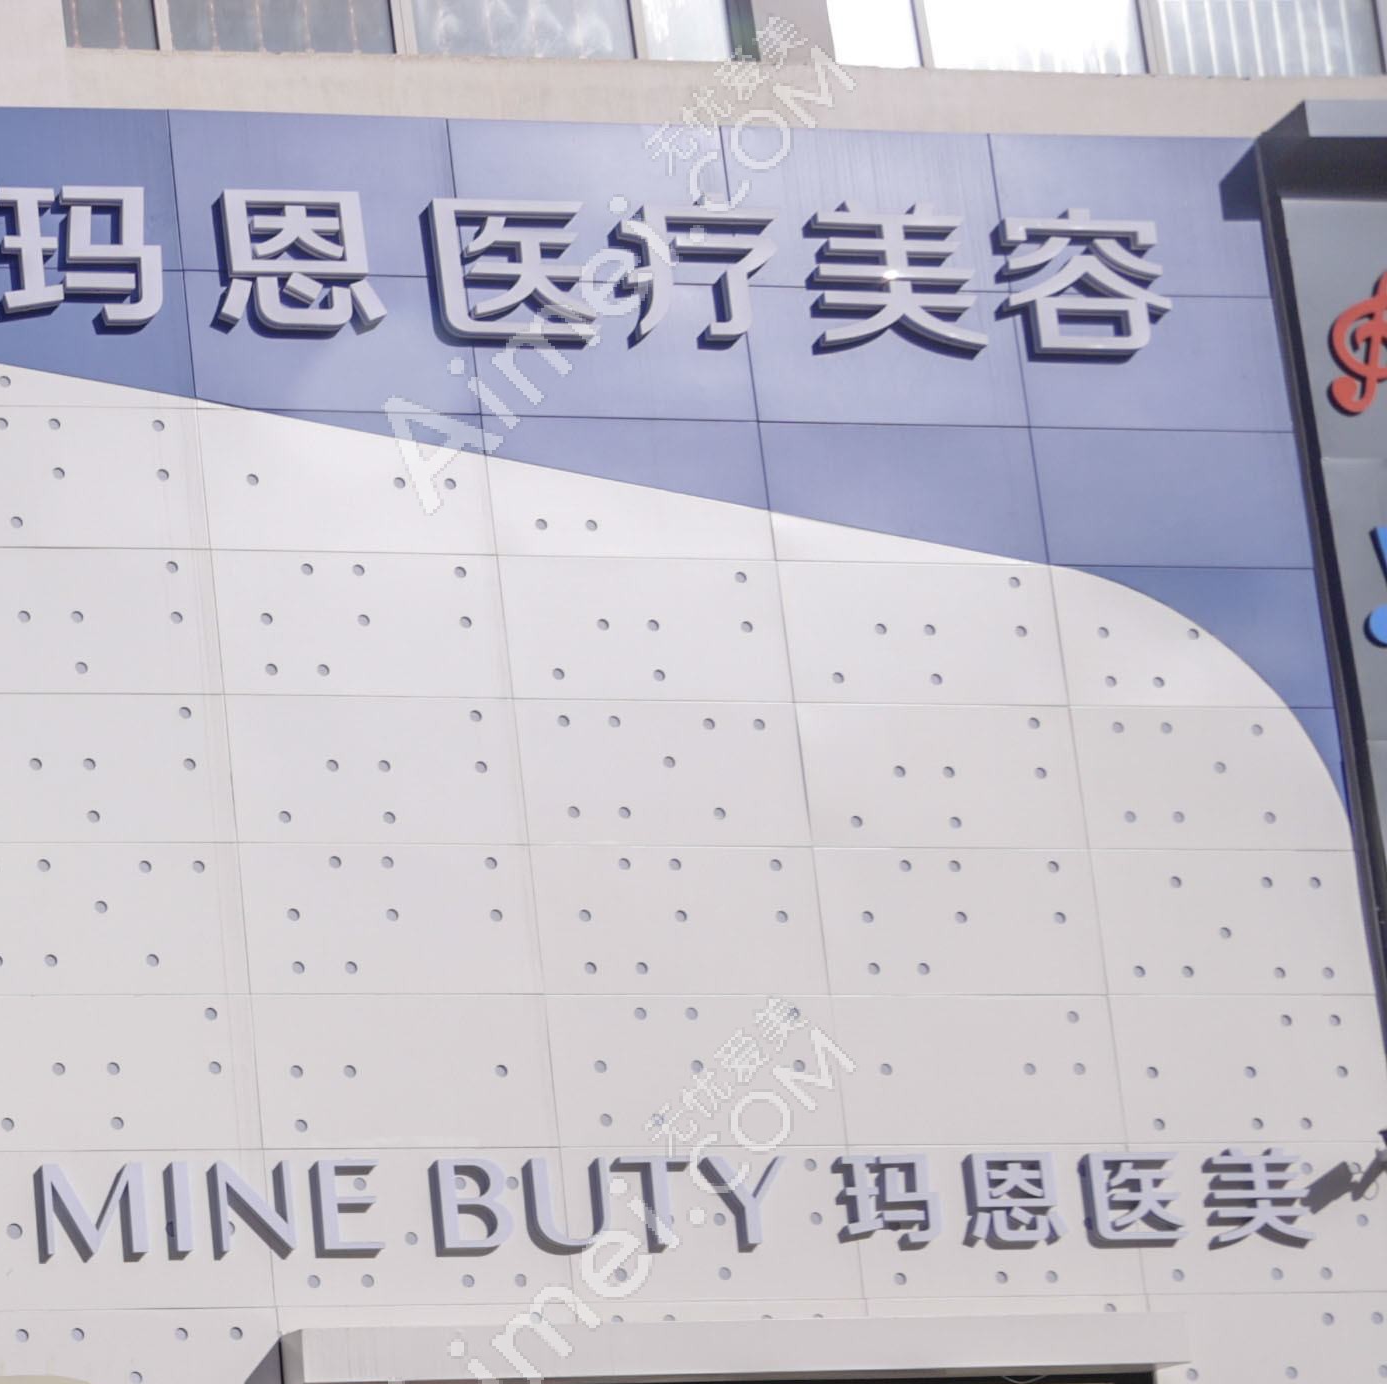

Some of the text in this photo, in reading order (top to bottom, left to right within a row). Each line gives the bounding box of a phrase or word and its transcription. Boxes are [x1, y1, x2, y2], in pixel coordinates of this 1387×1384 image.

[32, 1155, 787, 1262] MINE BUTY
[831, 1149, 1317, 1250] 玛恩医美
